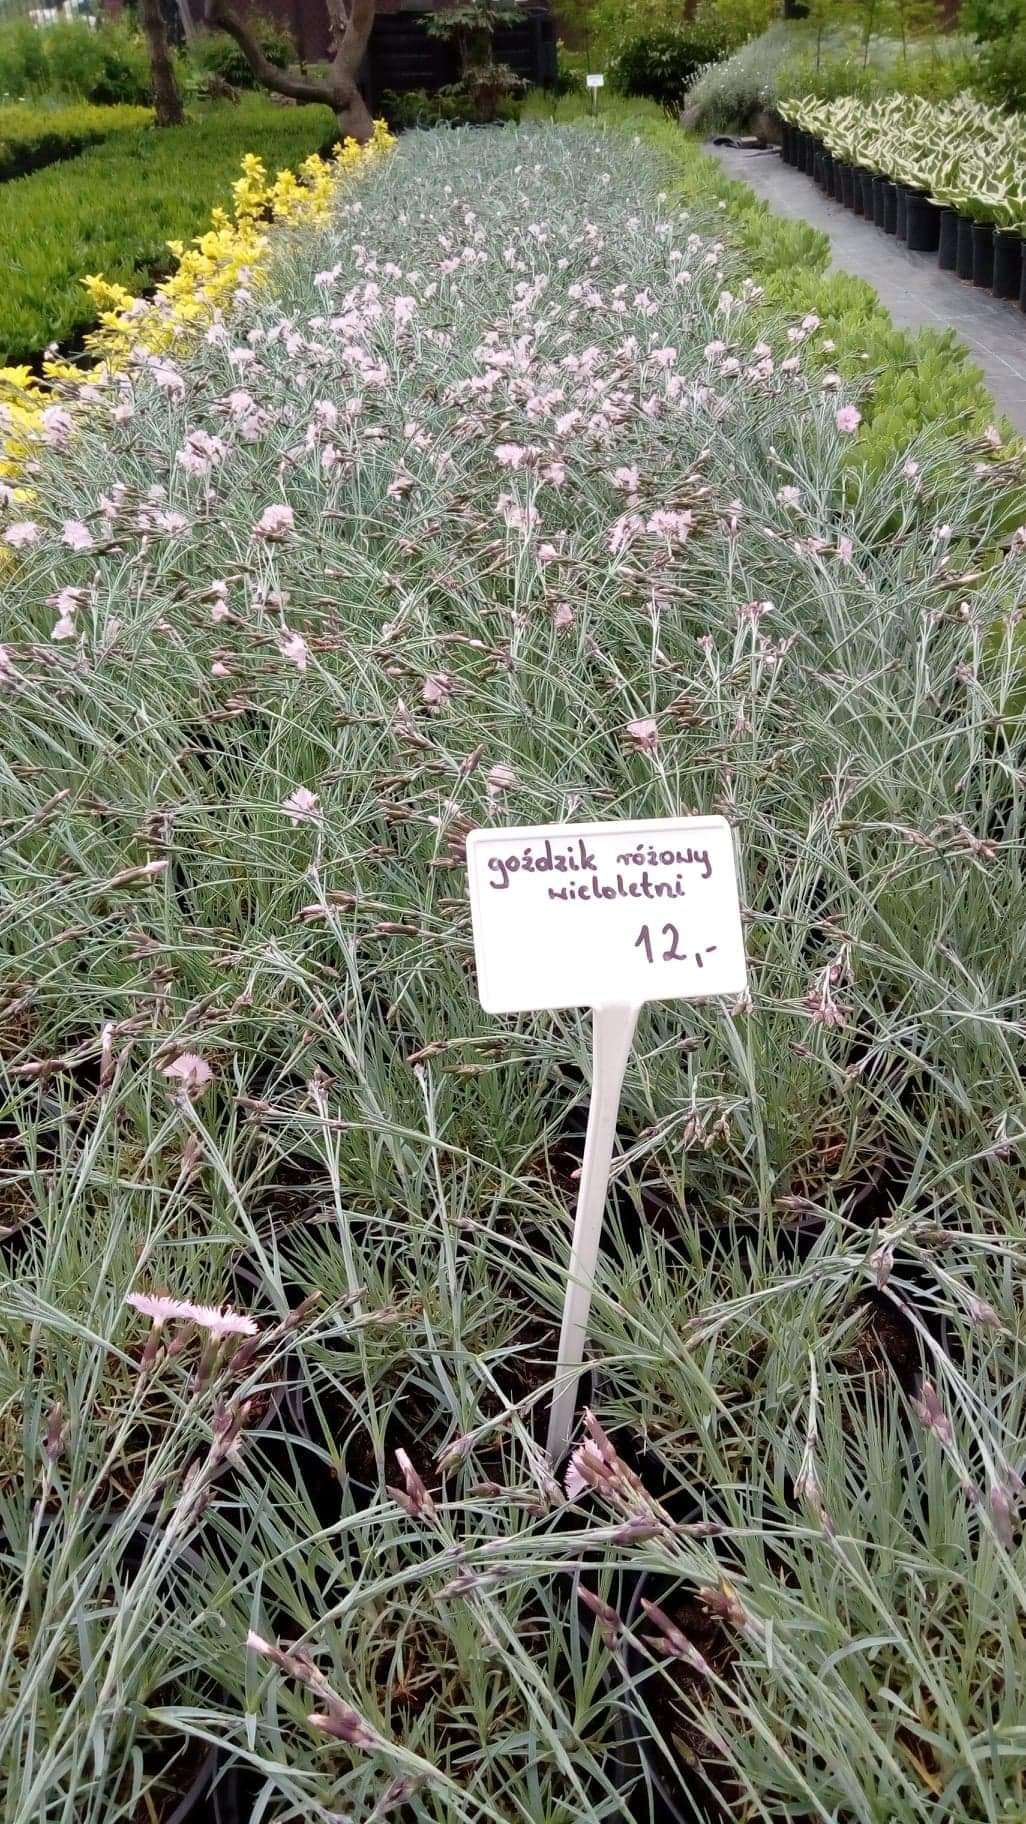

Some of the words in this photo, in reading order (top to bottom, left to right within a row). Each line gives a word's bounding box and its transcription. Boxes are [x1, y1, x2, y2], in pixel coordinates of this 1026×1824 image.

[488, 839, 598, 889] goździk
[617, 844, 712, 879] różowy
[548, 871, 685, 900] wieloletni
[634, 923, 717, 968] 12,-
